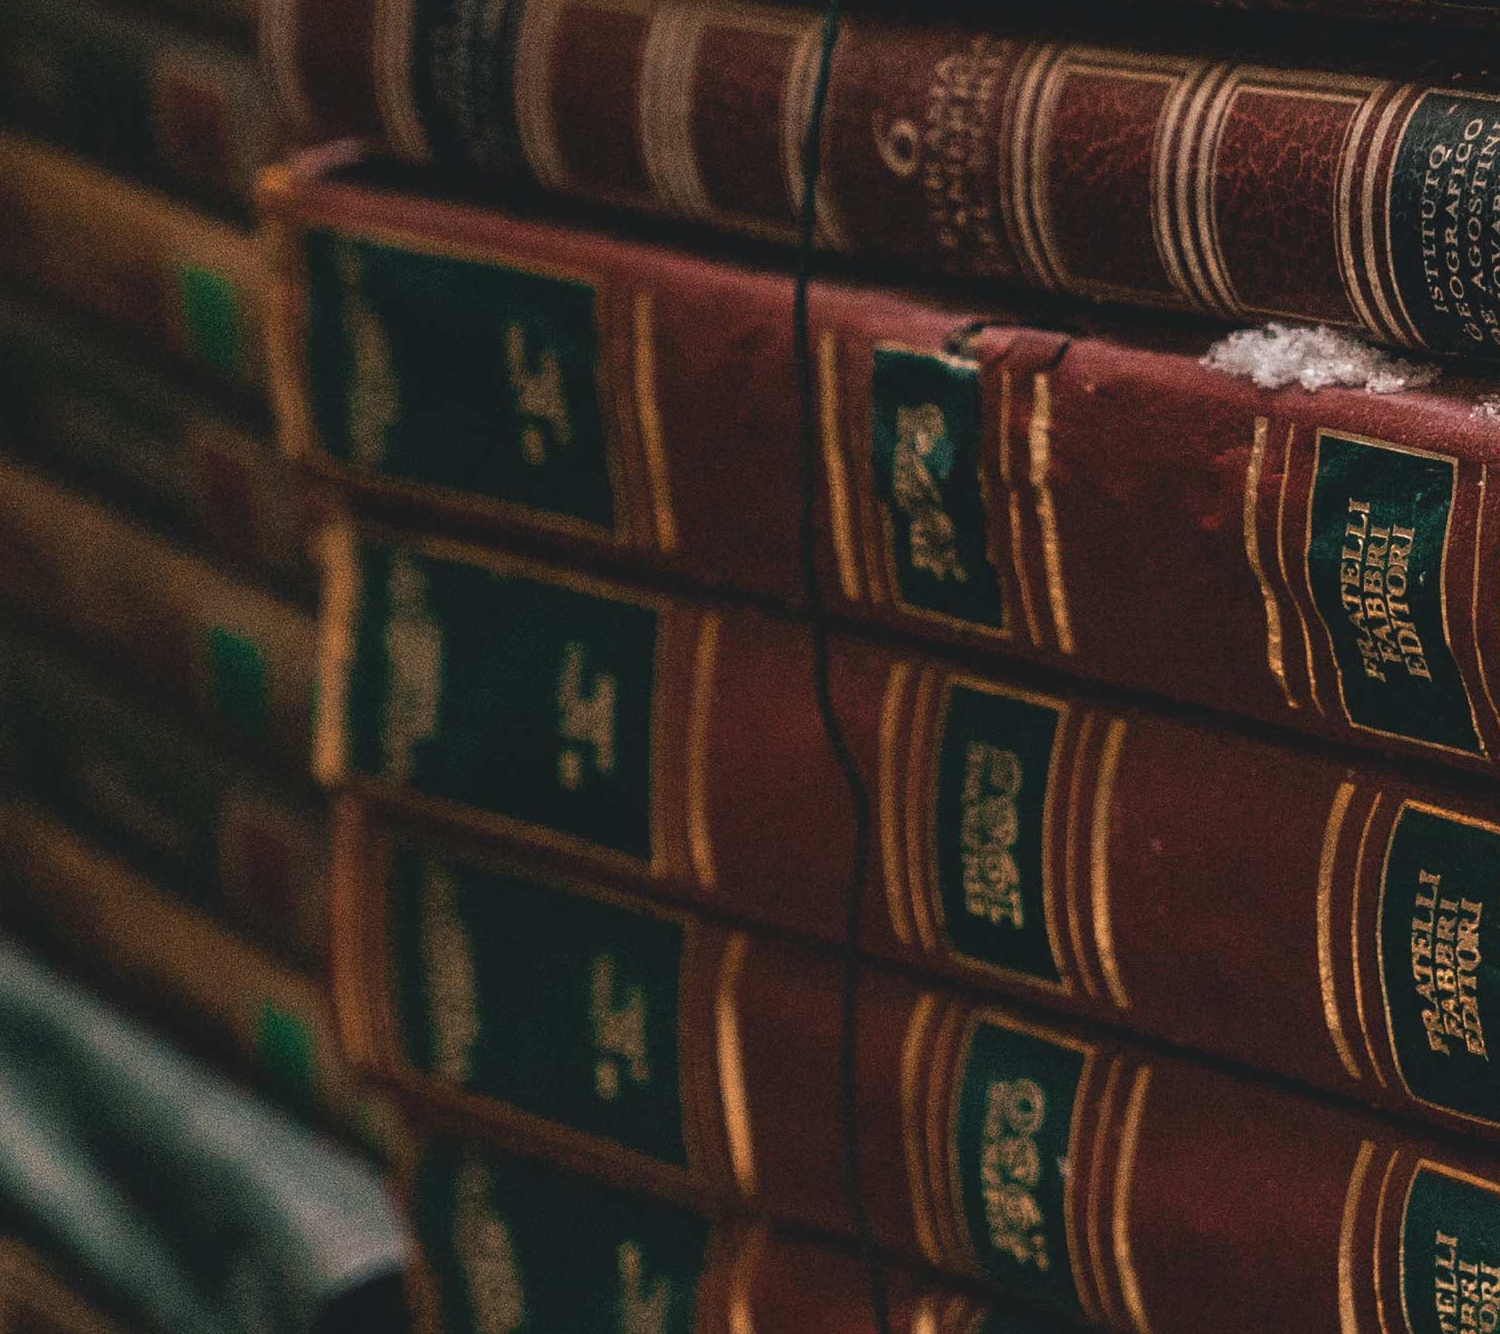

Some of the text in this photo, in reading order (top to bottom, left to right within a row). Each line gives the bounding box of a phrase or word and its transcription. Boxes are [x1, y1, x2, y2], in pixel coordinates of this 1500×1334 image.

[1421, 143, 1452, 315] ISTITUTO
[1445, 118, 1484, 342] GEOGRAFICO
[1340, 497, 1387, 683] FRATELLI
[1363, 524, 1403, 664] FABBRI
[1385, 522, 1433, 683] EDITORI
[1411, 869, 1450, 1056] FRATELLI
[1436, 897, 1465, 1041] FABBRI
[1455, 897, 1488, 1059] EDITORI
